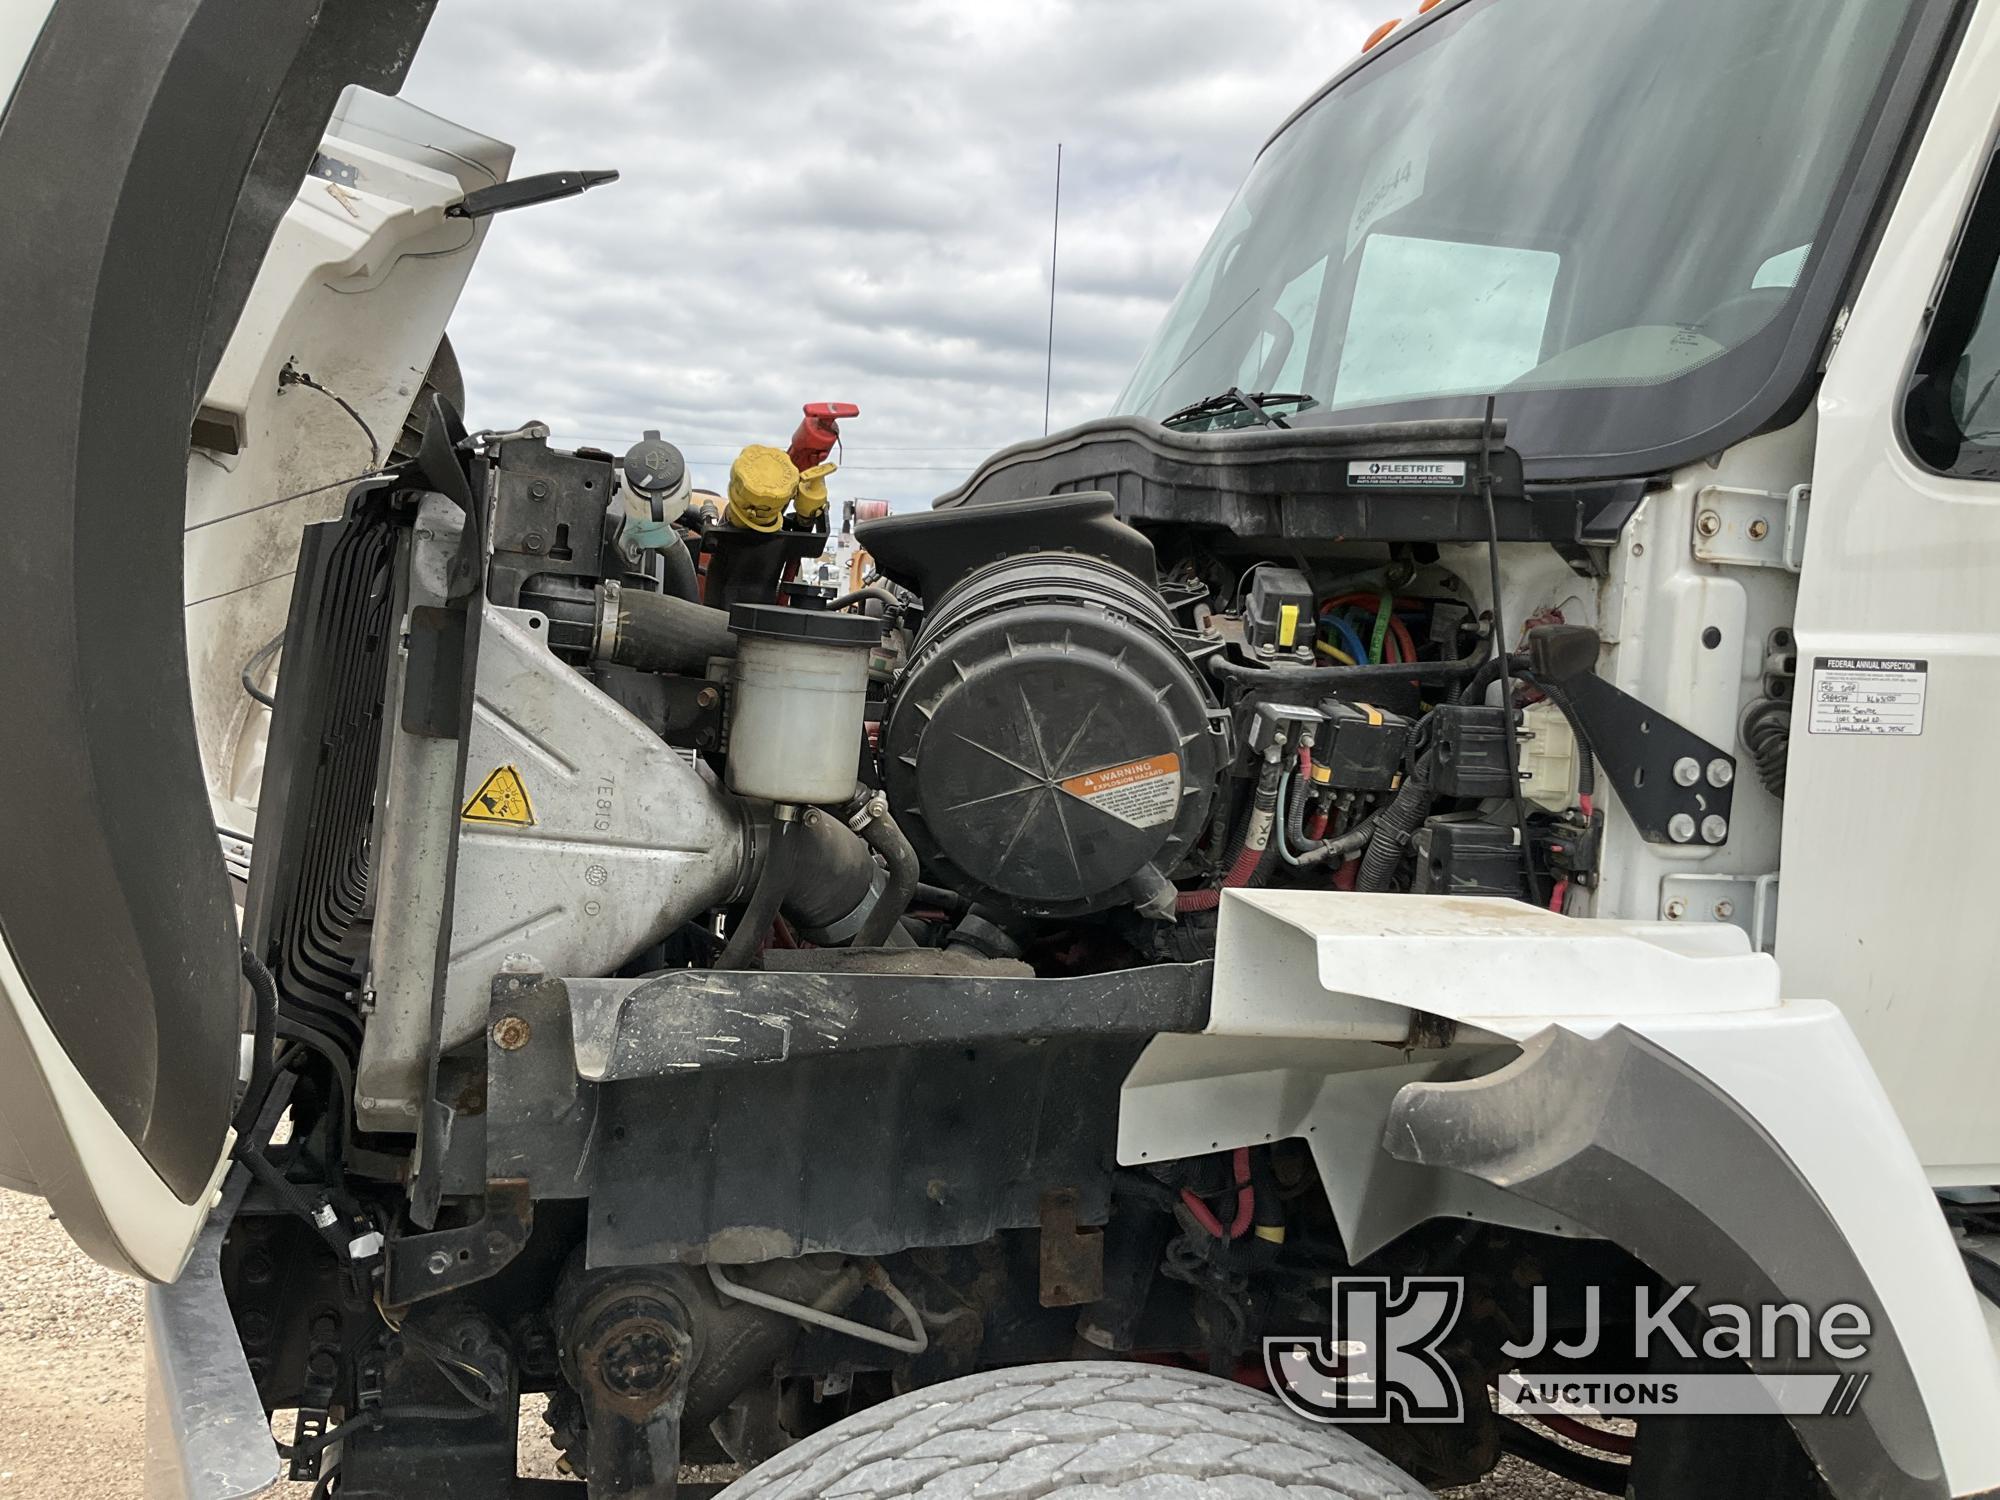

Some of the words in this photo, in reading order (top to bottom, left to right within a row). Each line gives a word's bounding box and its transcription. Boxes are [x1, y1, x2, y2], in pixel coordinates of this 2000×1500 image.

[1381, 464, 1443, 473] FLEETRITE
[1828, 660, 1855, 668] FEDERAL
[1856, 660, 1880, 670] ANNUAL
[1881, 662, 1916, 670] INSPECTION
[1099, 762, 1151, 782] WARNING
[1093, 777, 1133, 791] EXPLOSION
[1135, 769, 1163, 780] HAZARD
